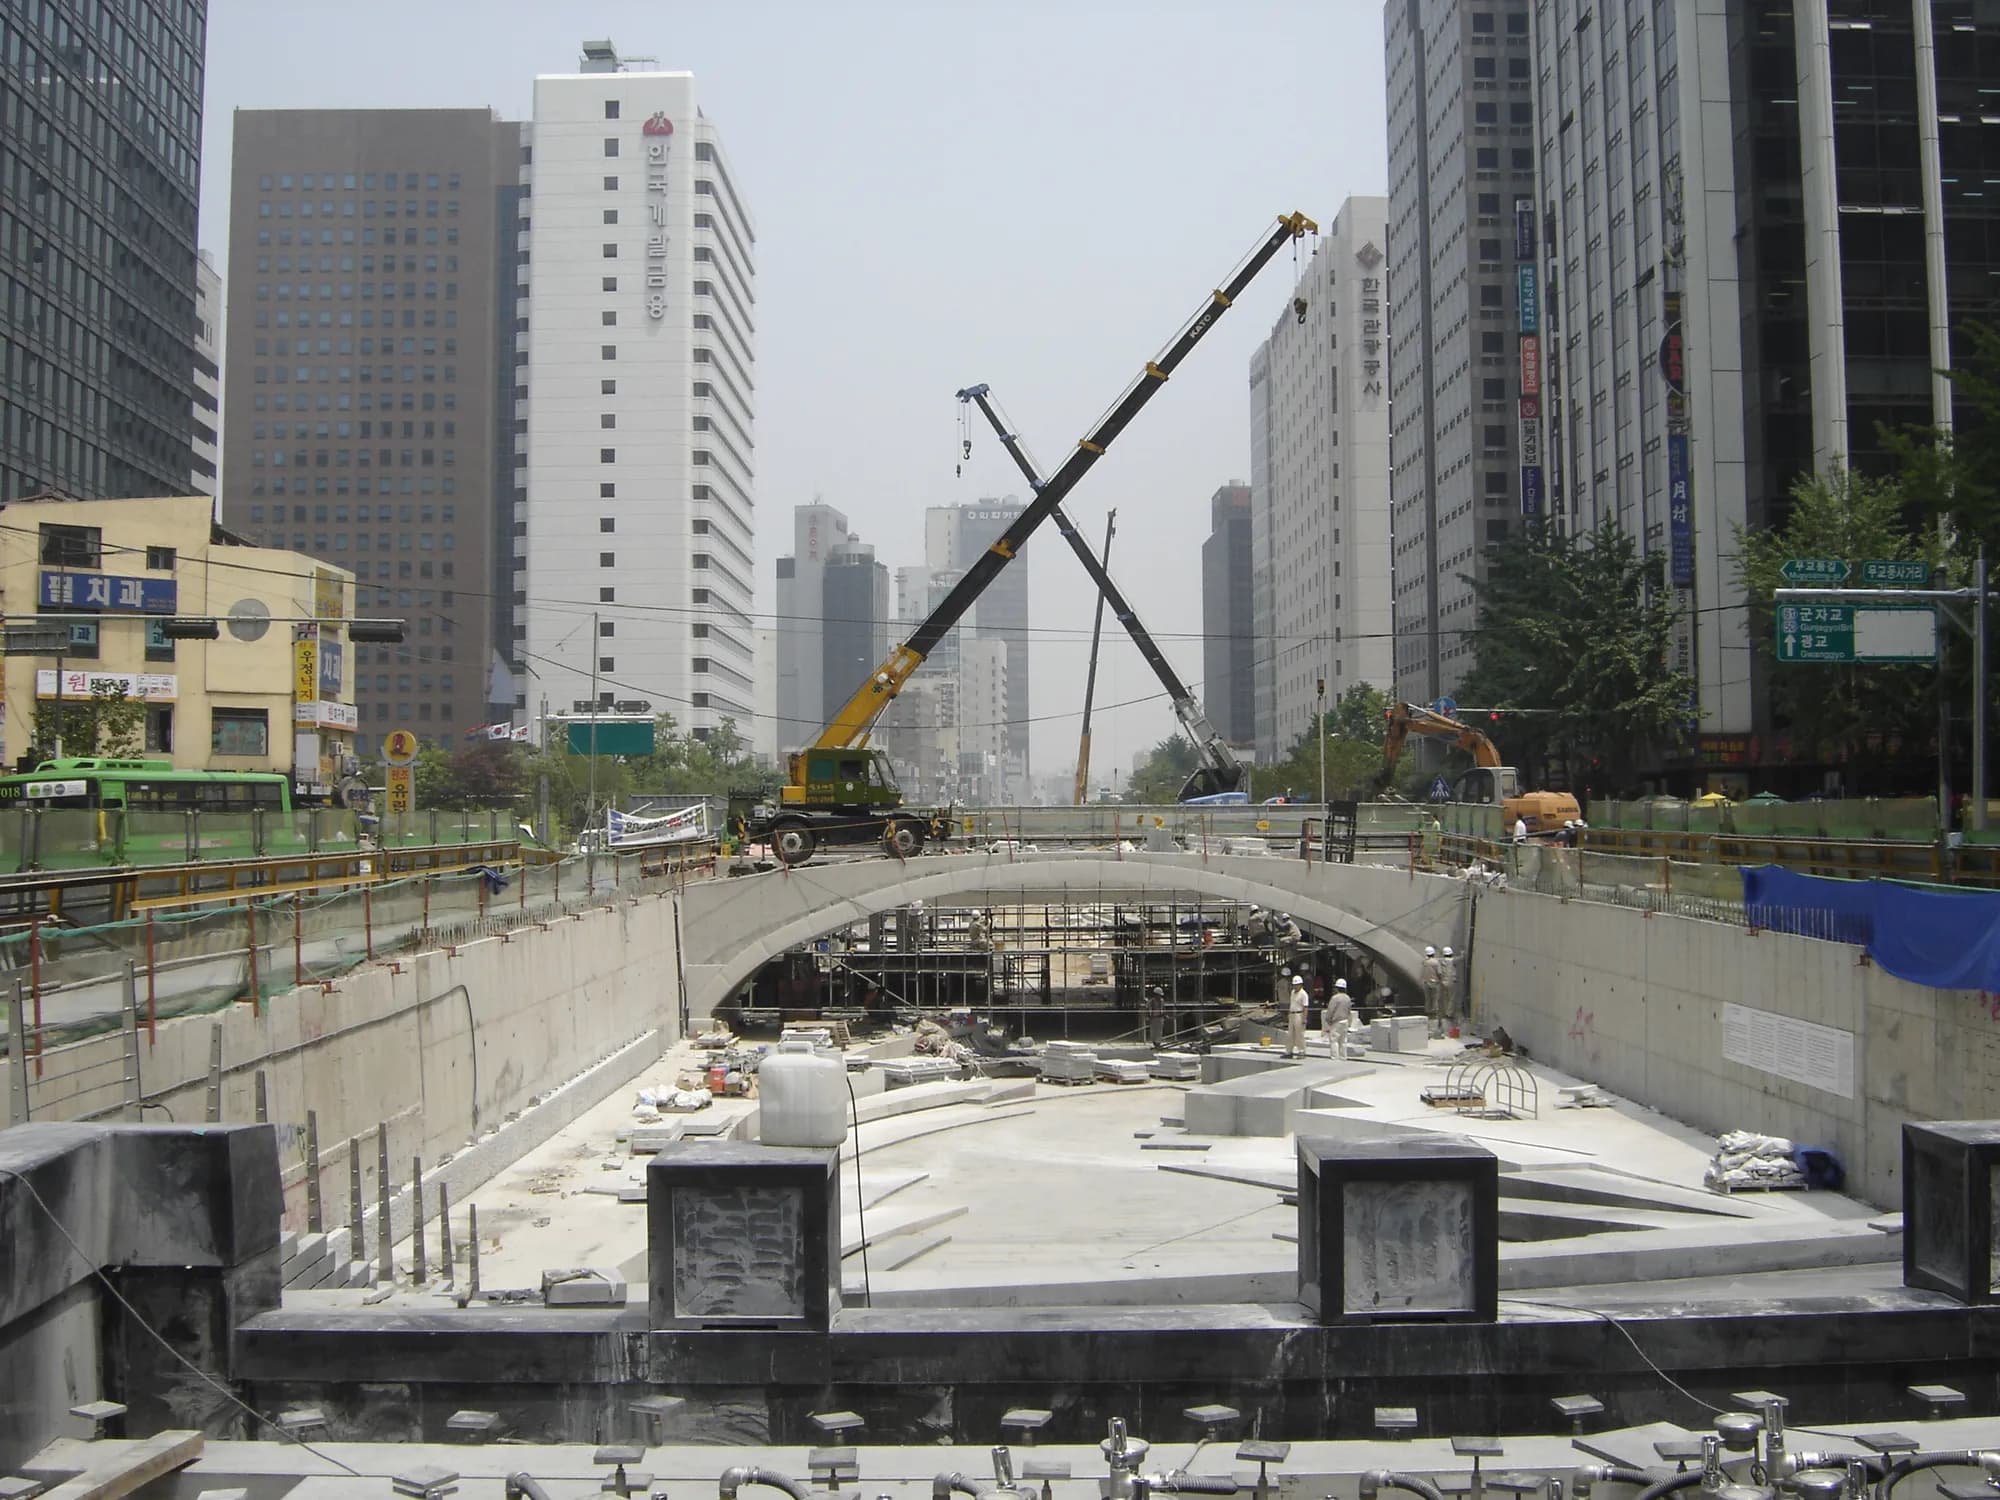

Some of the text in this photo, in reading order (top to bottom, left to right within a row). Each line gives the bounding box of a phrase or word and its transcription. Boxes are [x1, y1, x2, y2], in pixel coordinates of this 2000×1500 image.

[1189, 314, 1212, 338] KATO
[1361, 278, 1382, 397] 한국관광공사
[1868, 565, 1923, 579] 무교동사거리
[1800, 607, 1843, 622] 군자교
[1800, 634, 1828, 648] 광교
[67, 672, 87, 692] 원
[299, 650, 315, 701] 우정낙지
